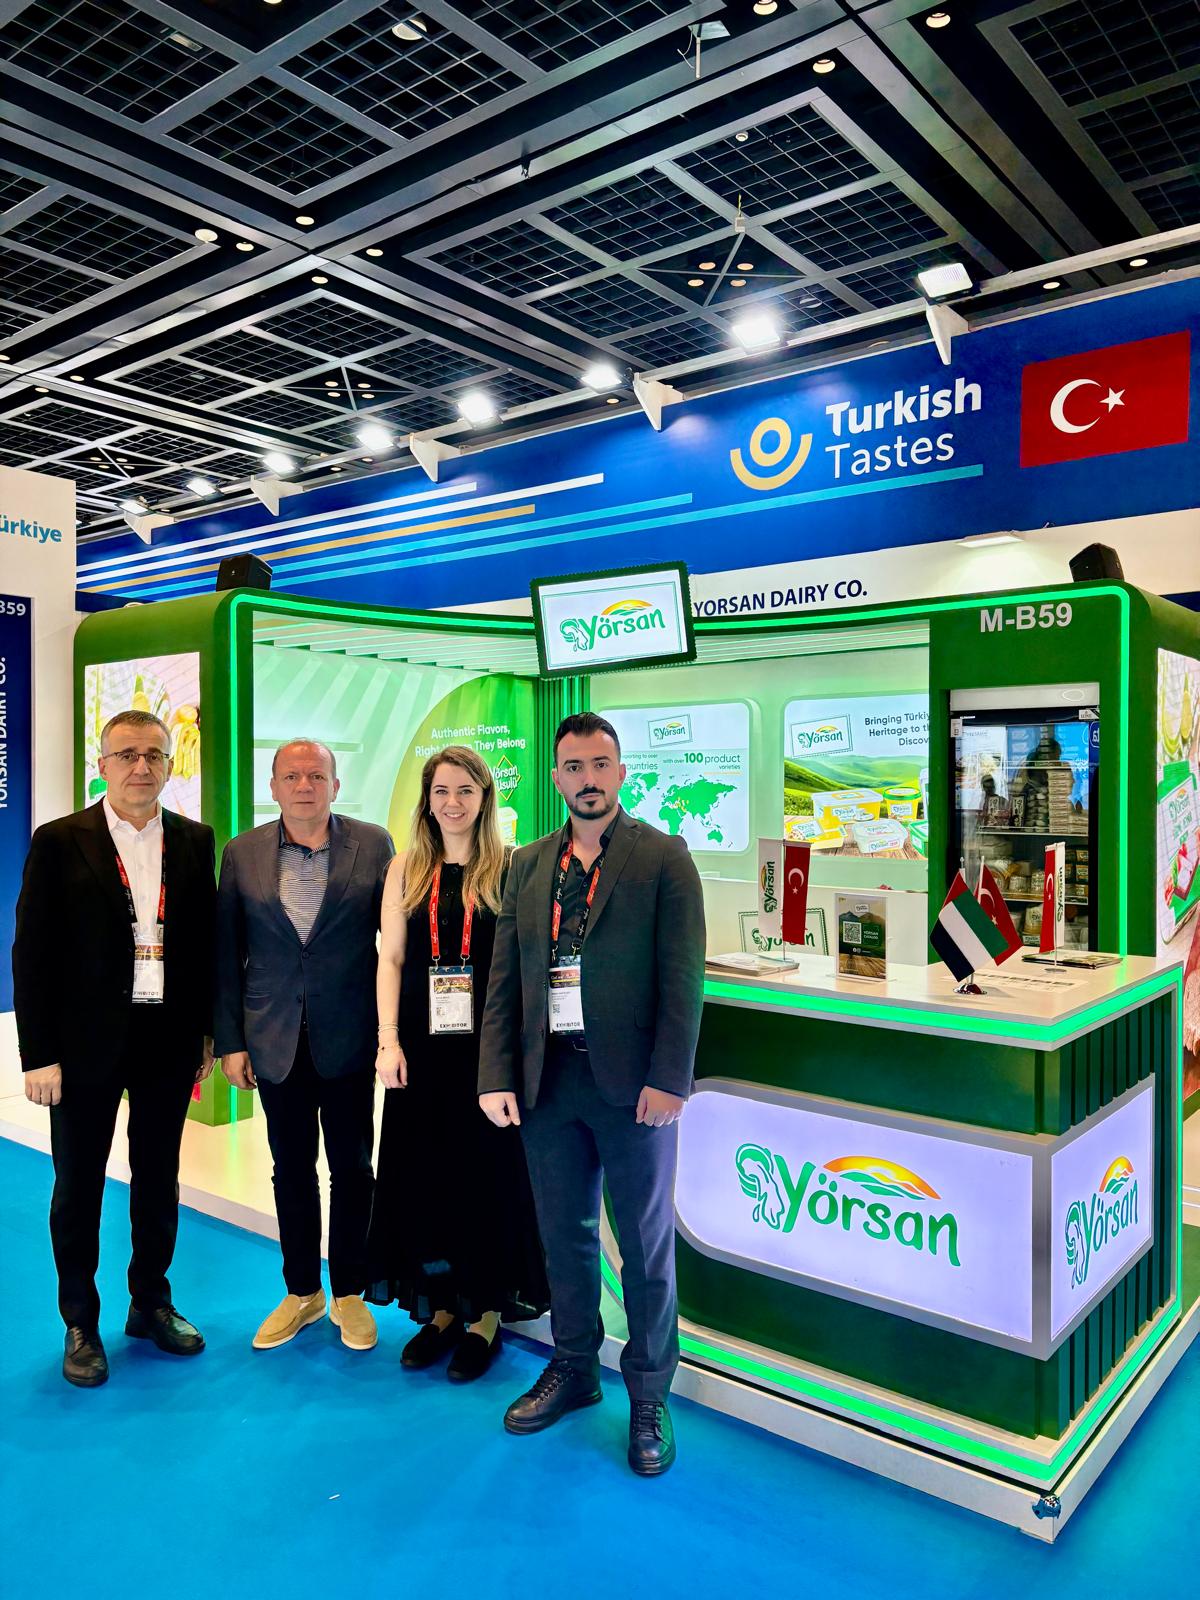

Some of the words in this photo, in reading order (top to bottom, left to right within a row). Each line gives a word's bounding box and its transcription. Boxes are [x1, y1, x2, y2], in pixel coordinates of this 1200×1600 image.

[825, 377, 982, 437] Turkish
[825, 433, 955, 479] Tastes
[694, 592, 765, 617] YORSAN
[770, 584, 829, 608] DAIRY
[834, 579, 868, 599] CO.
[578, 608, 666, 650] Yörsan
[980, 602, 1073, 633] M-B59
[431, 725, 476, 739] Authentic
[477, 723, 511, 736] Flavors,
[864, 715, 902, 726] Bringing
[869, 727, 909, 737] Heritage
[910, 725, 920, 733] to
[474, 740, 496, 752] They
[497, 737, 526, 749] Belong
[805, 730, 843, 748] Yörsan
[684, 752, 704, 764] 100
[704, 754, 741, 765] product
[773, 1154, 961, 1267] Yörsan
[1081, 1179, 1138, 1282] Yörsan
